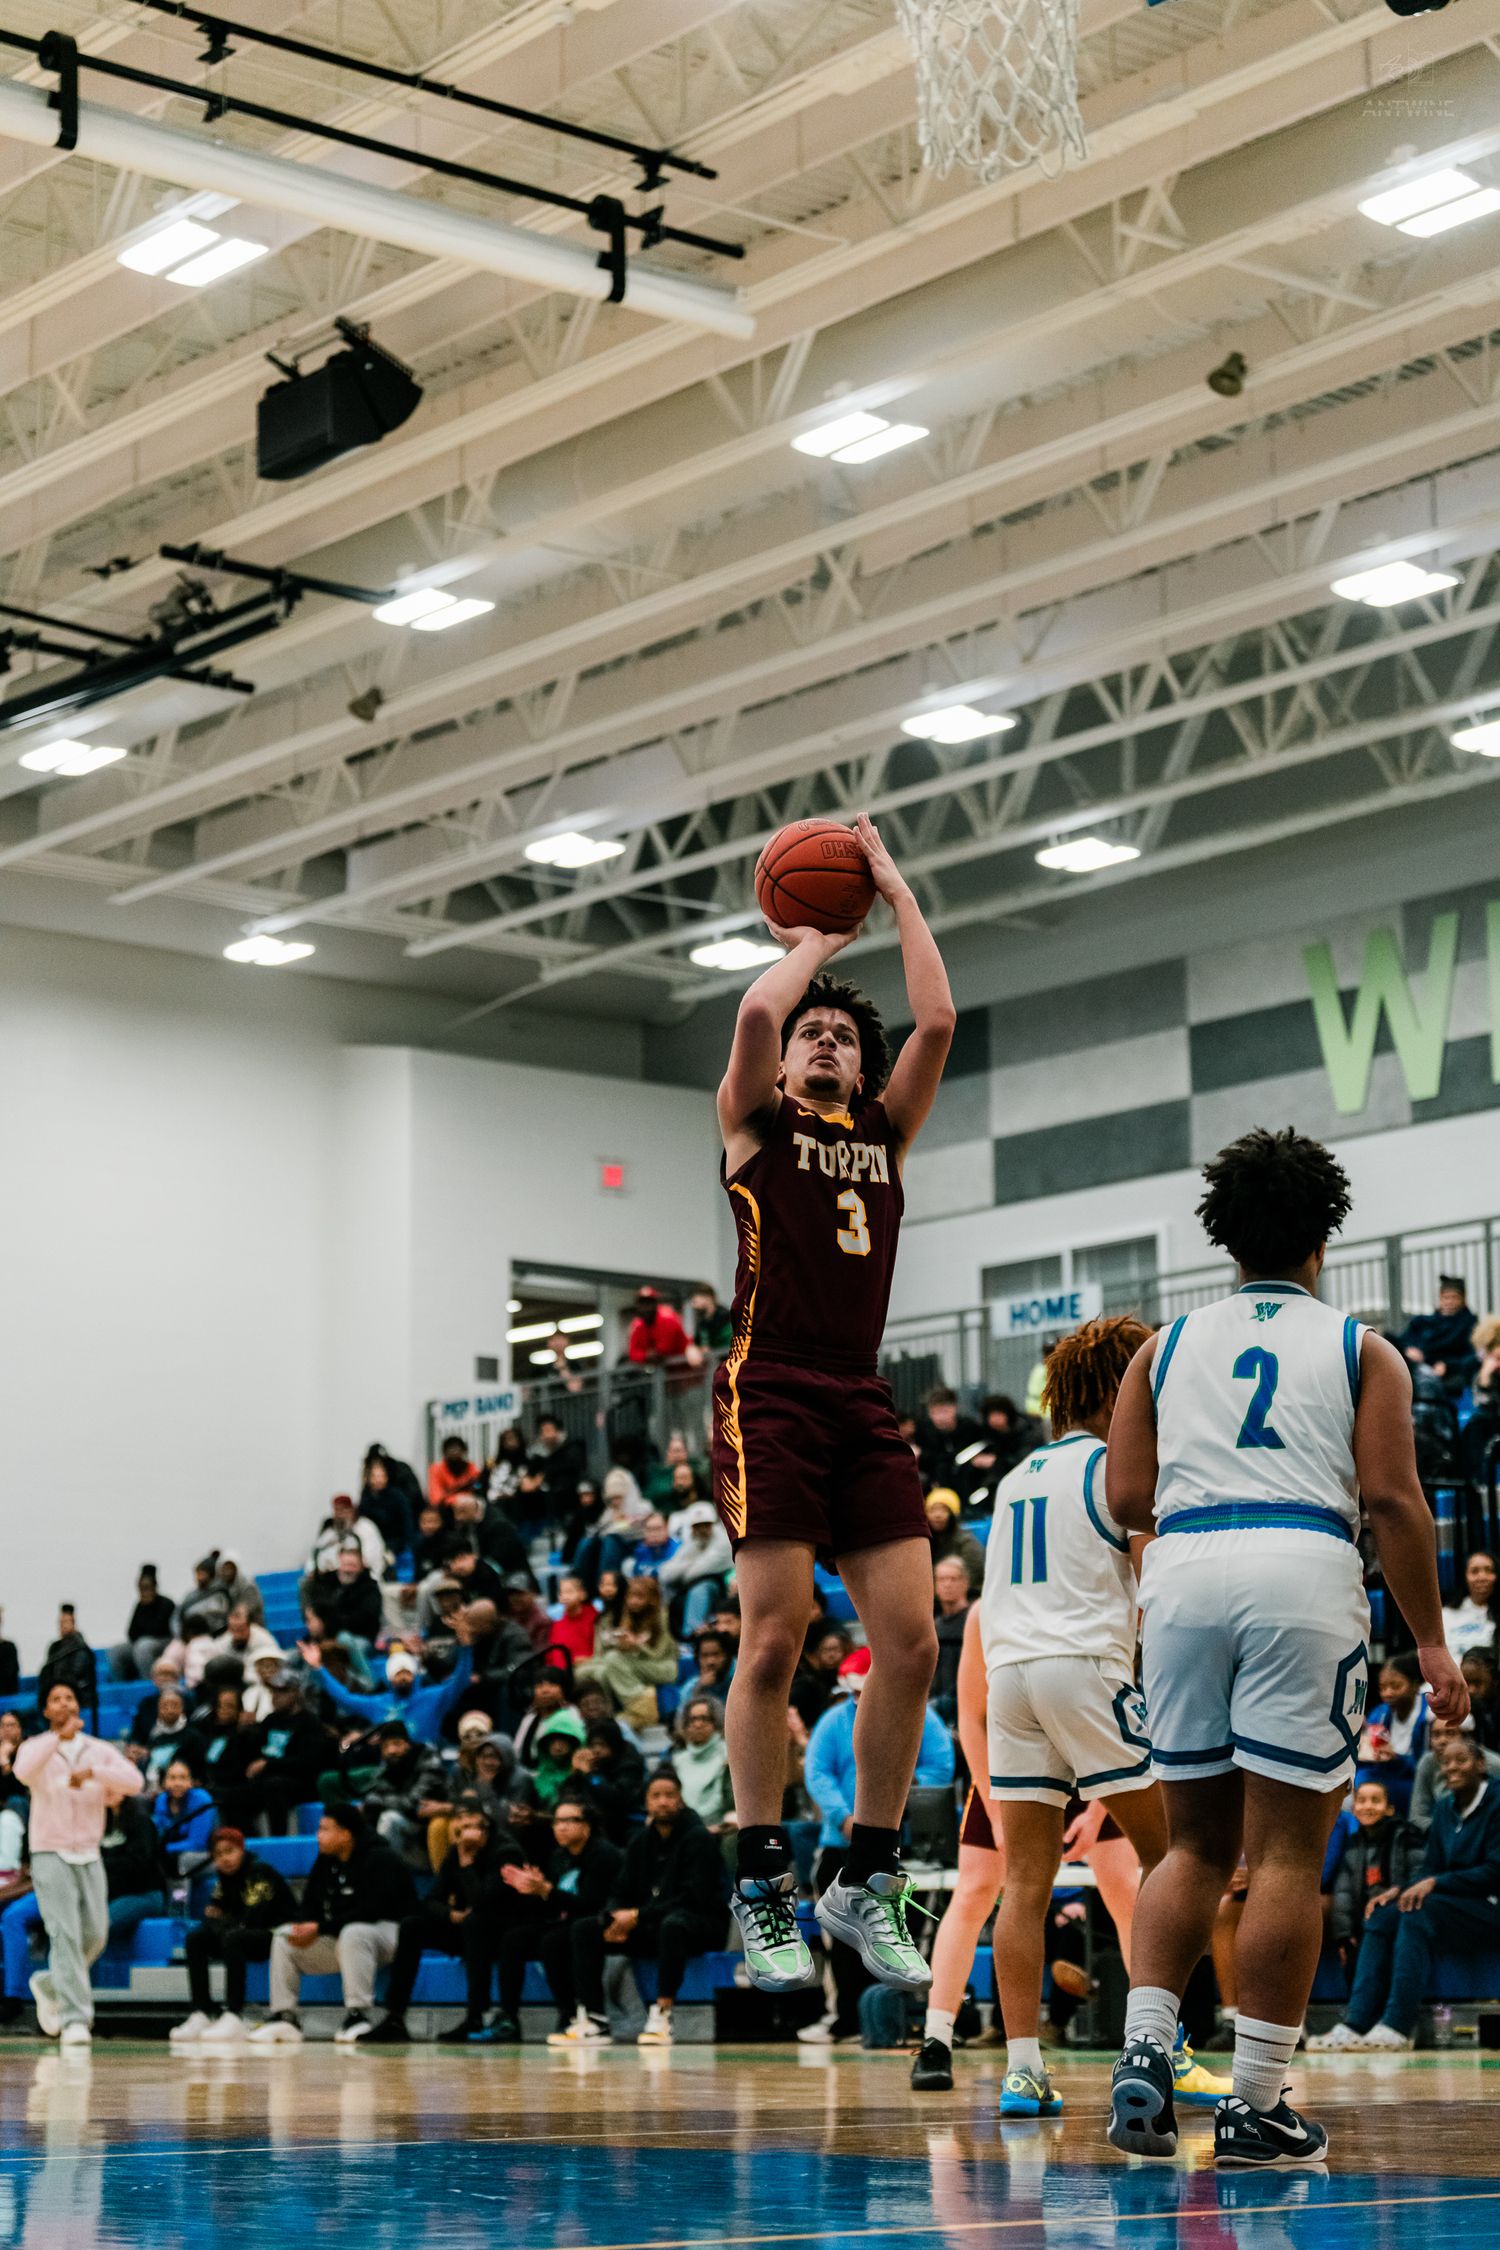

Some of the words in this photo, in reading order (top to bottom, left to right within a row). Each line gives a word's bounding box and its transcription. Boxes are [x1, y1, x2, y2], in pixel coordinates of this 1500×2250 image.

[837, 1188, 871, 1256] 3
[1010, 1293, 1082, 1329] HOME
[1232, 1345, 1286, 1449] 2
[1009, 1496, 1048, 1585] 11
